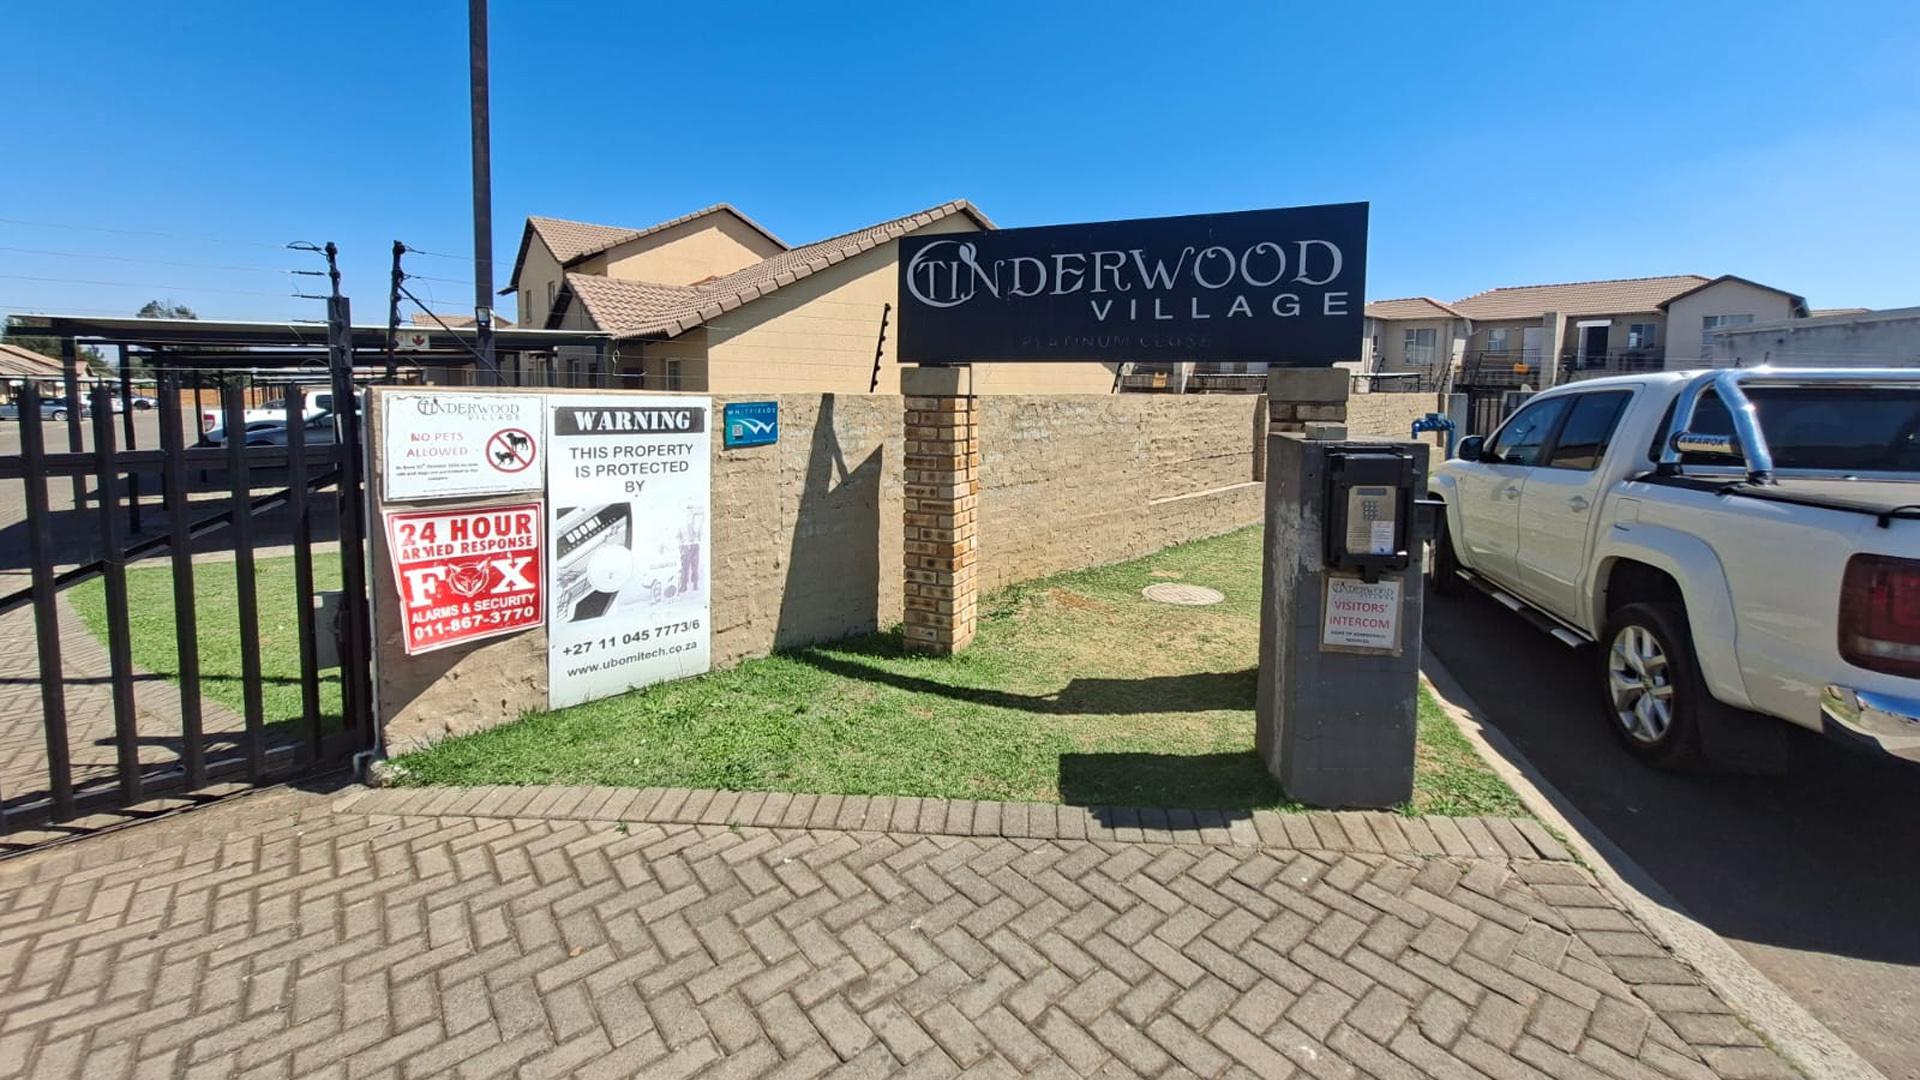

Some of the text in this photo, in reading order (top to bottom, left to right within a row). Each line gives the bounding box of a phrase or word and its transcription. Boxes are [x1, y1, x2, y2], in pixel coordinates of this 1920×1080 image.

[906, 239, 1344, 308] TINDERWOOD
[1091, 292, 1349, 321] VILLAGE
[574, 411, 690, 431] WARNING
[411, 432, 464, 442] NO PETS
[406, 447, 468, 457] ALLOWED
[569, 444, 693, 459] THIS PROPERTY
[575, 460, 688, 478] IS PROTECTED
[625, 480, 645, 492] BY
[400, 514, 532, 546] 24 HOUR
[566, 516, 602, 544] UBOMI
[402, 535, 532, 560] ARMED RESPONSE
[412, 593, 535, 624] ALARMS & SECURITY
[414, 606, 534, 640] 011-867-3770
[1329, 616, 1390, 629] INTERCOM
[562, 619, 700, 656] +27 11 045 7773/6
[567, 640, 697, 677] www.ubomitech.co.za
